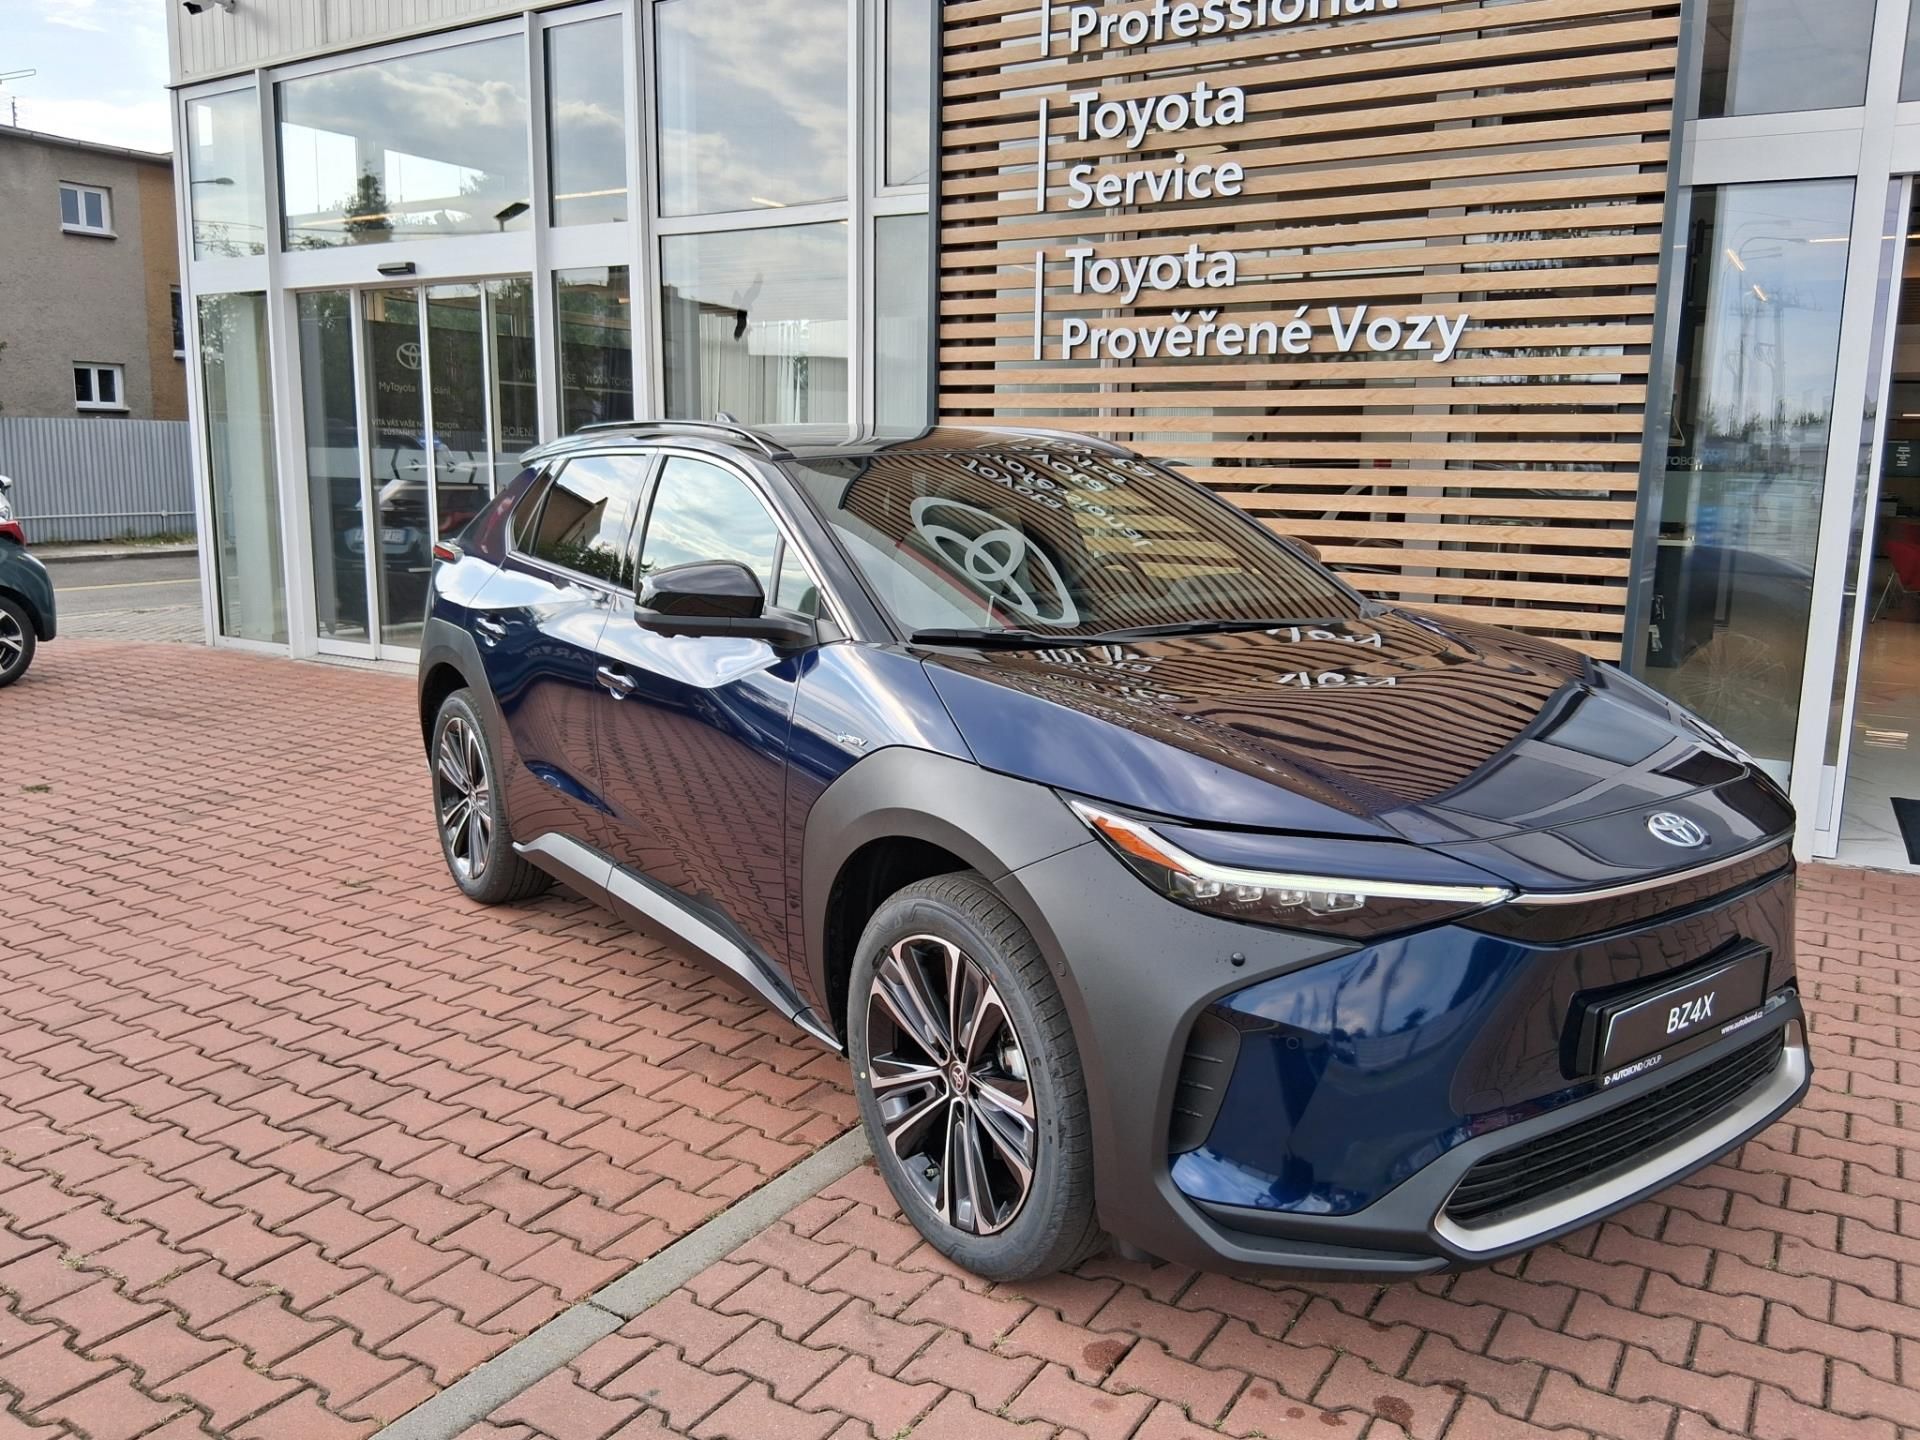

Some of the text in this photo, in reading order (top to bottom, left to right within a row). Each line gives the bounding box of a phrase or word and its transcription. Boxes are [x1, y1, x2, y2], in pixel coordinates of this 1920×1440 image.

[1070, 0, 1398, 52] Profession
[1069, 81, 1246, 150] Toyota
[1067, 153, 1245, 210] Service
[1064, 243, 1238, 305] Toyota
[1061, 304, 1470, 363] Prověřené Vozy
[1666, 991, 1716, 1035] BZ4X
